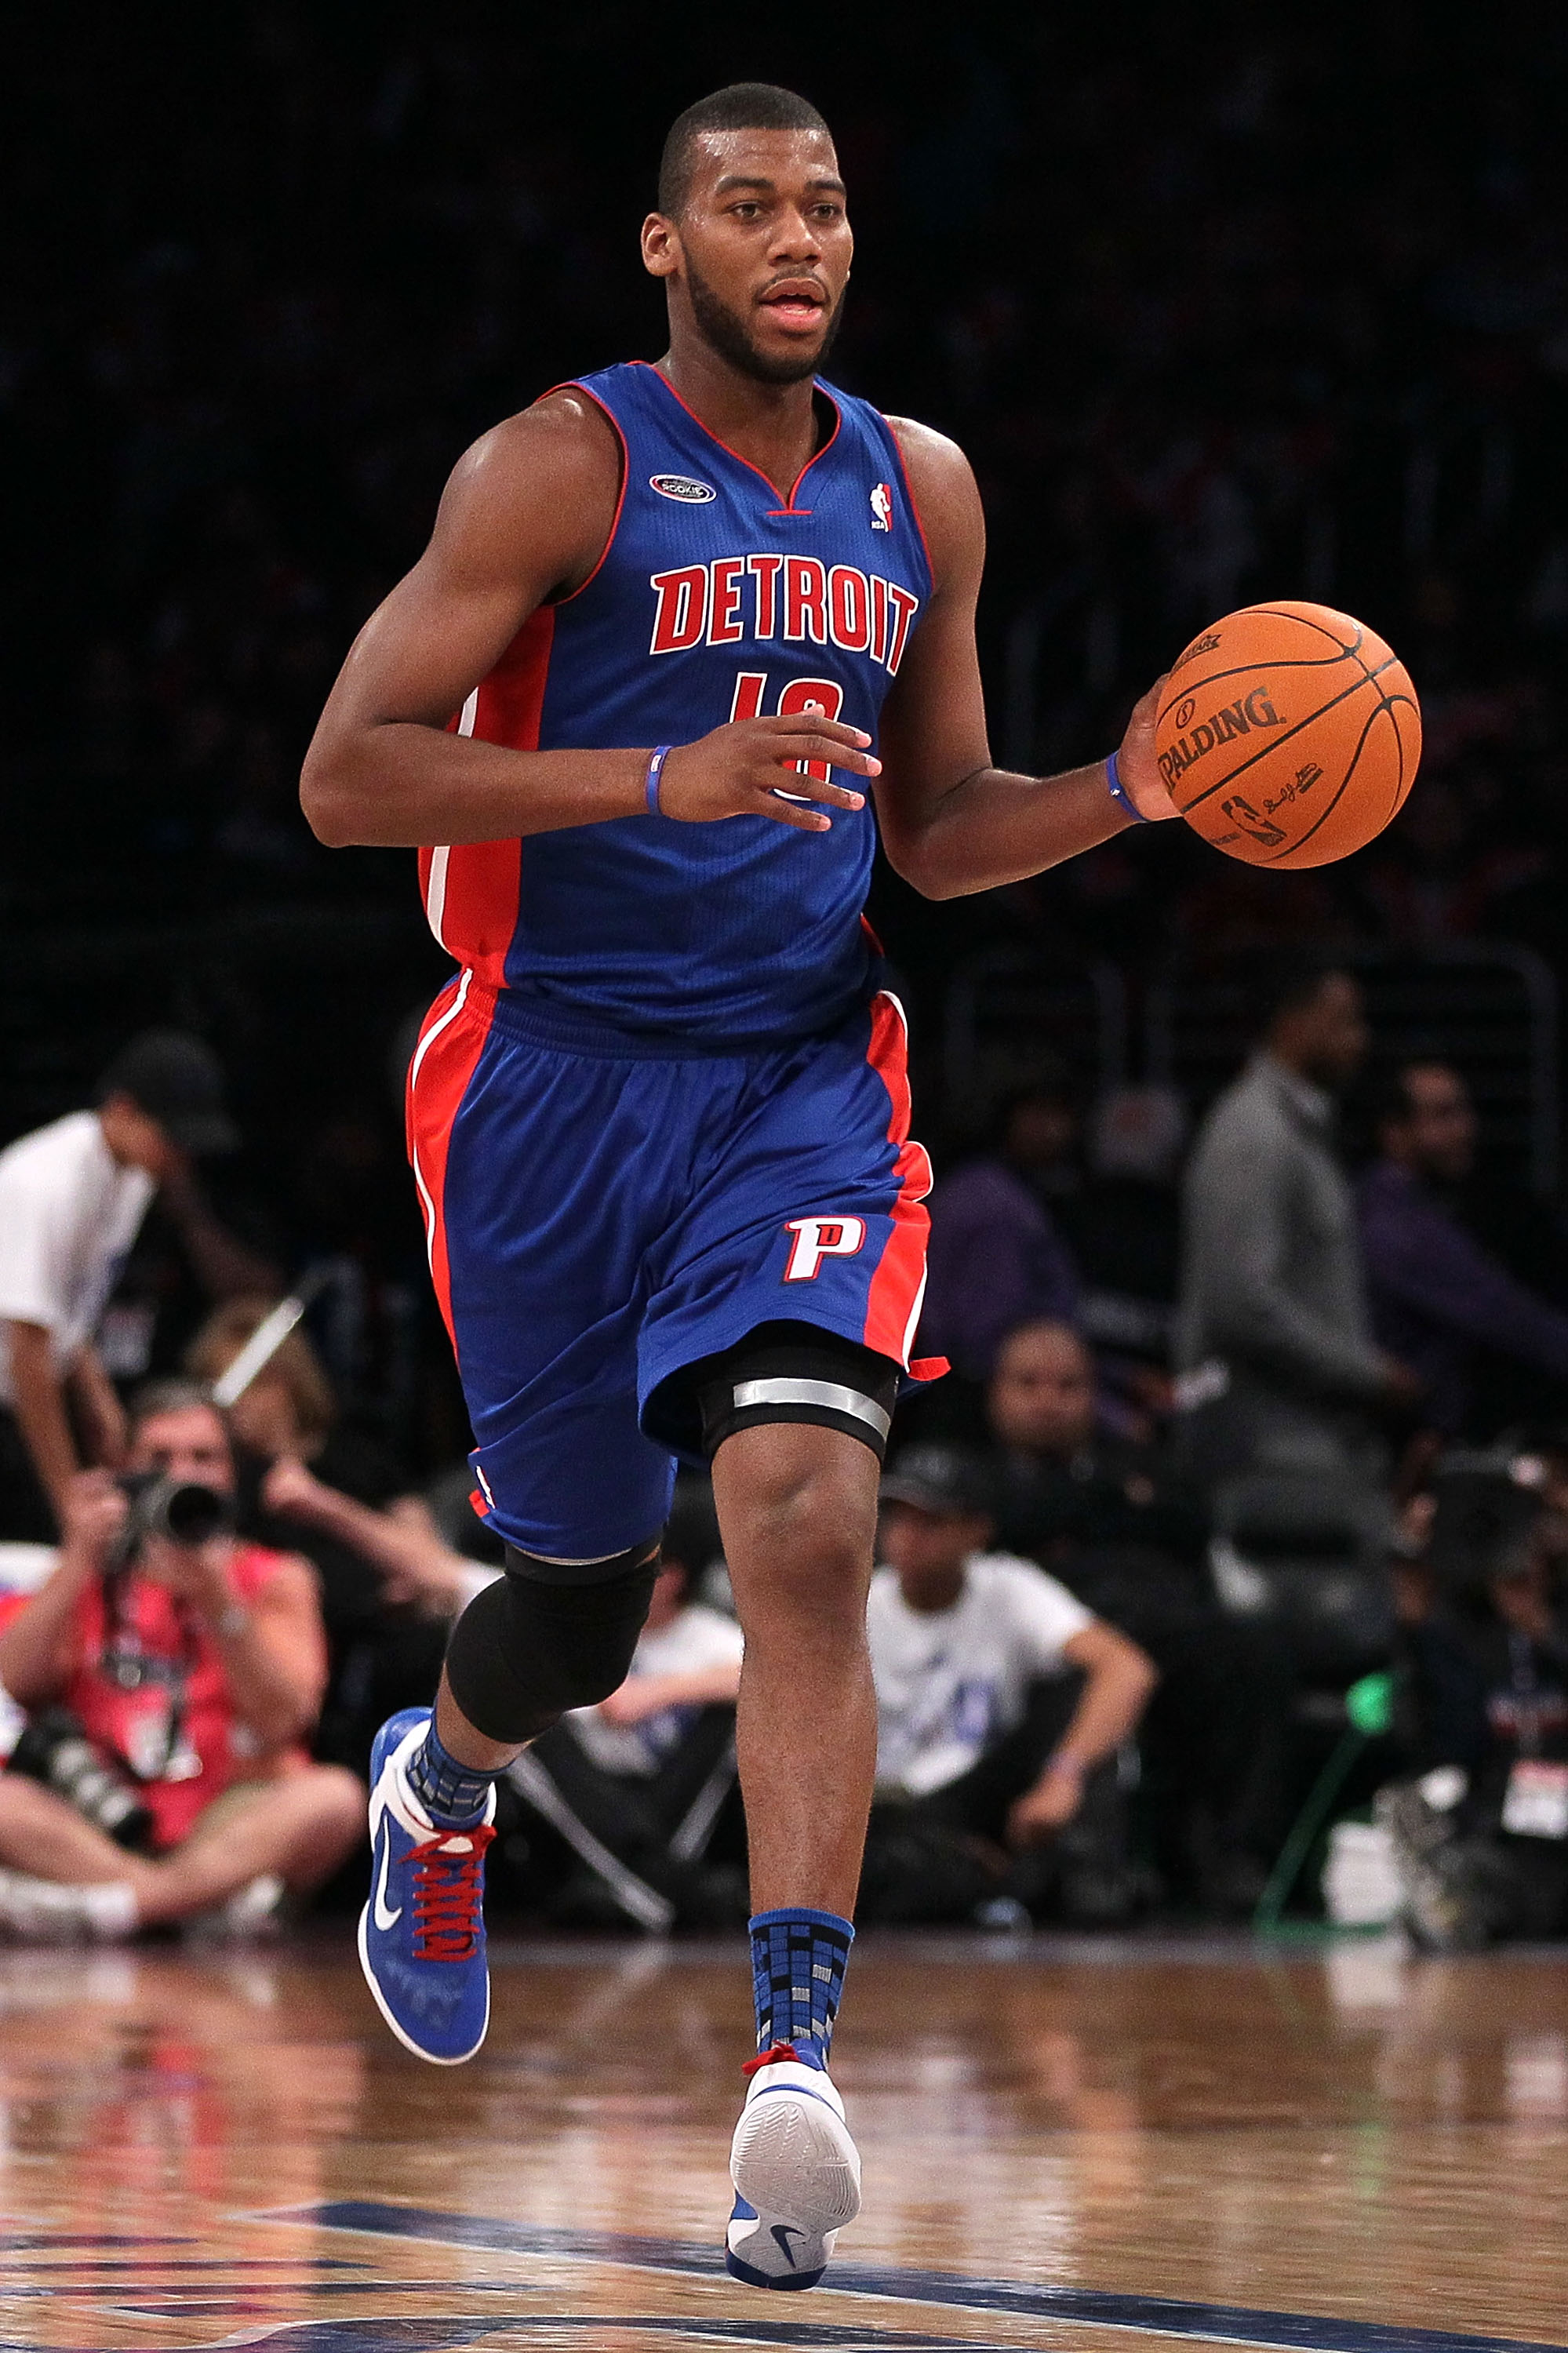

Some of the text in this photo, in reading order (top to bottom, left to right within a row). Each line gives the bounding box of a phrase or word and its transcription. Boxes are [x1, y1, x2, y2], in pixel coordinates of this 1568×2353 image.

[649, 553, 919, 676] DETROIT
[1157, 686, 1281, 798] PALDING
[783, 1215, 867, 1283] P
